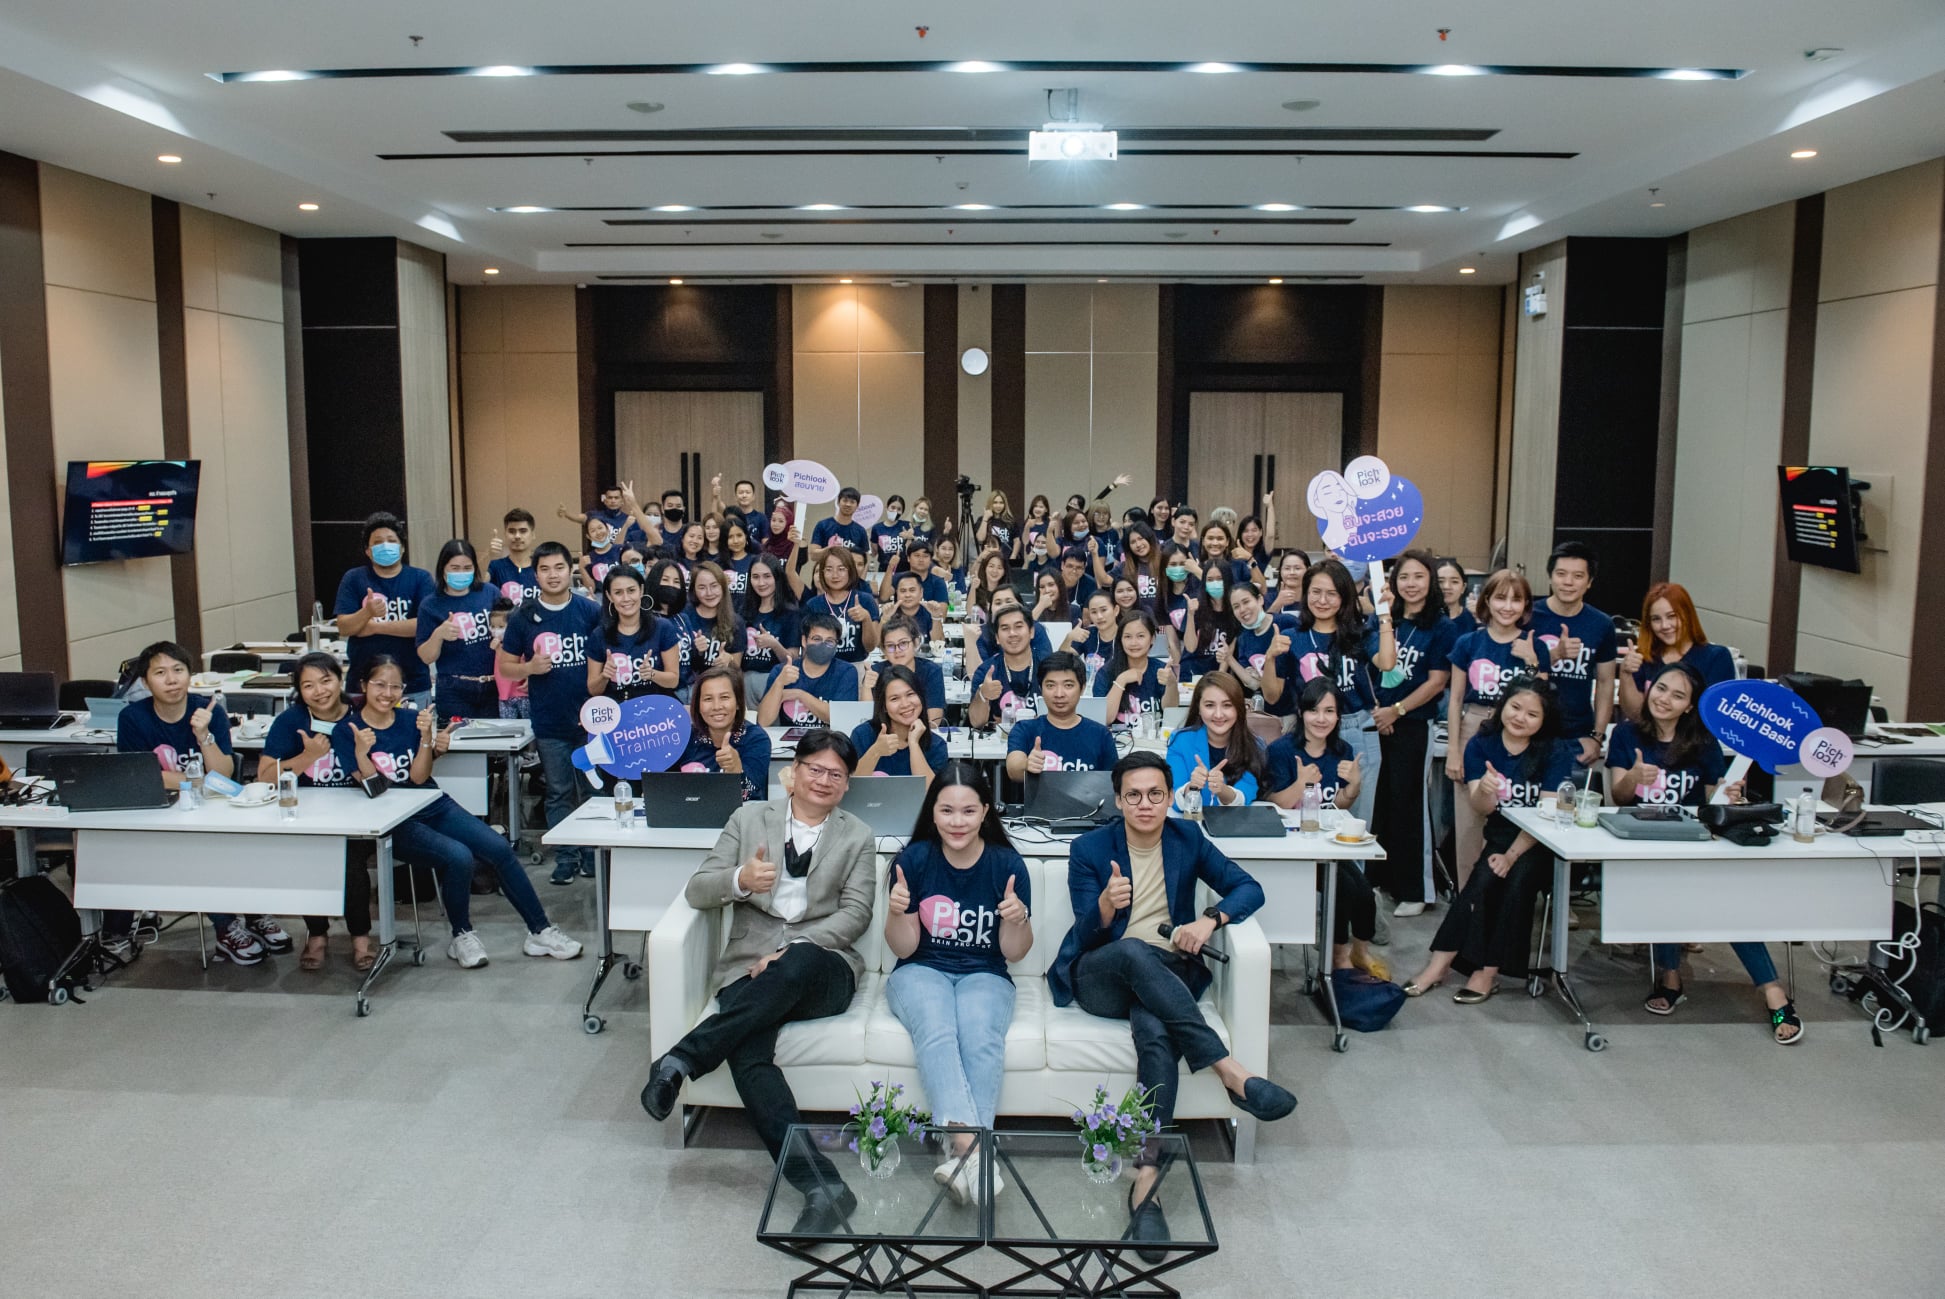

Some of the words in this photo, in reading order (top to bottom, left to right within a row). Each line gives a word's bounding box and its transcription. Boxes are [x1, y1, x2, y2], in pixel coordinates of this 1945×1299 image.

[770, 471, 785, 479] Pich
[794, 472, 827, 484] Pichlook
[1357, 468, 1380, 480] Pich
[545, 632, 585, 653] Pich
[551, 649, 586, 664] ook
[1551, 657, 1588, 676] ook
[591, 706, 613, 718] Pich
[1736, 693, 1795, 732] Pichlook
[613, 718, 677, 745] Pichlook
[1717, 697, 1759, 730] ไม่สอน
[1758, 723, 1797, 750] Basic
[616, 731, 680, 757] Training
[1817, 740, 1844, 761] Pich
[1660, 769, 1695, 789] ich
[932, 901, 994, 930] Pich
